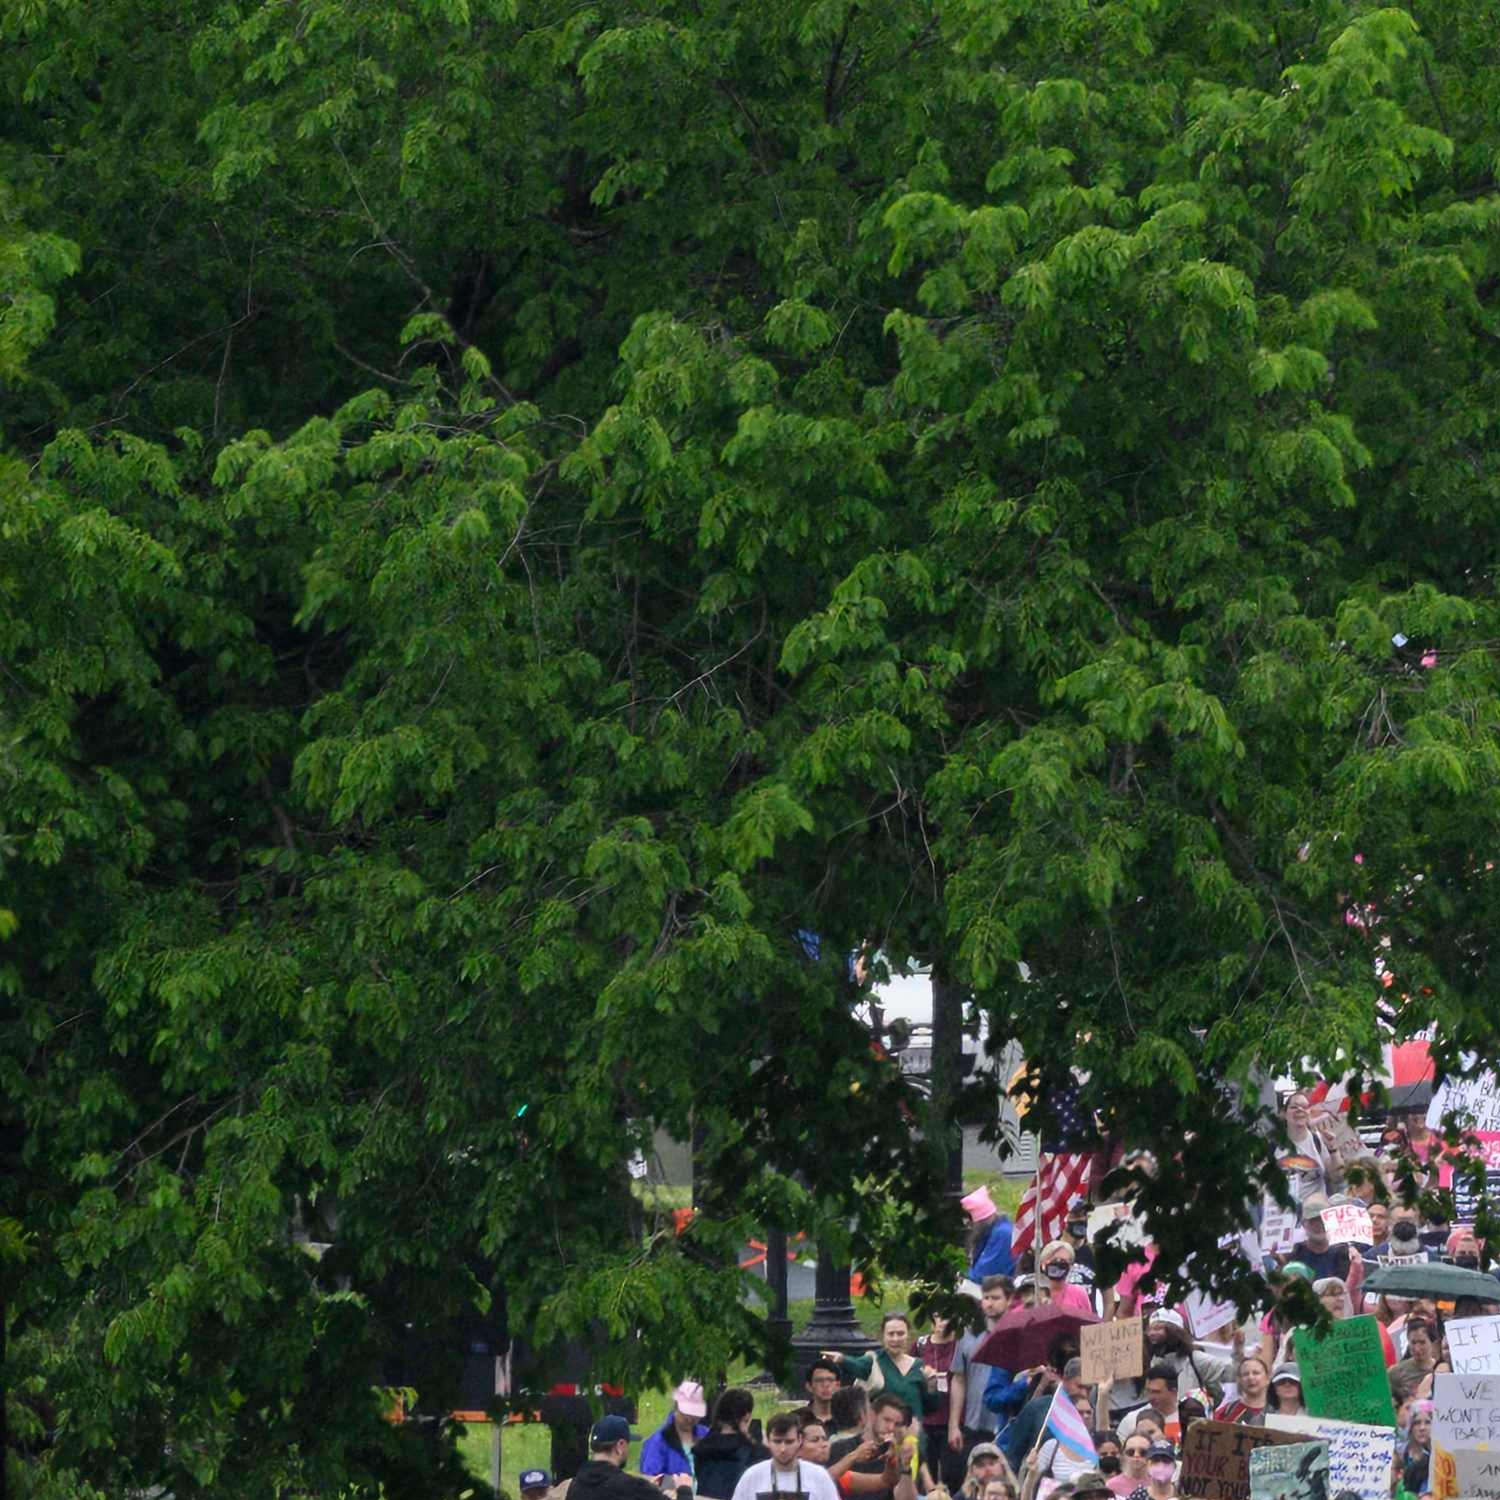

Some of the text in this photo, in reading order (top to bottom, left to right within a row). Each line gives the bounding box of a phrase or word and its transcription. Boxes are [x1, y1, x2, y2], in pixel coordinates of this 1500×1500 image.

[1451, 1323, 1479, 1347] IF
[1454, 1355, 1492, 1376] NOT
[1462, 1380, 1495, 1401] WE
